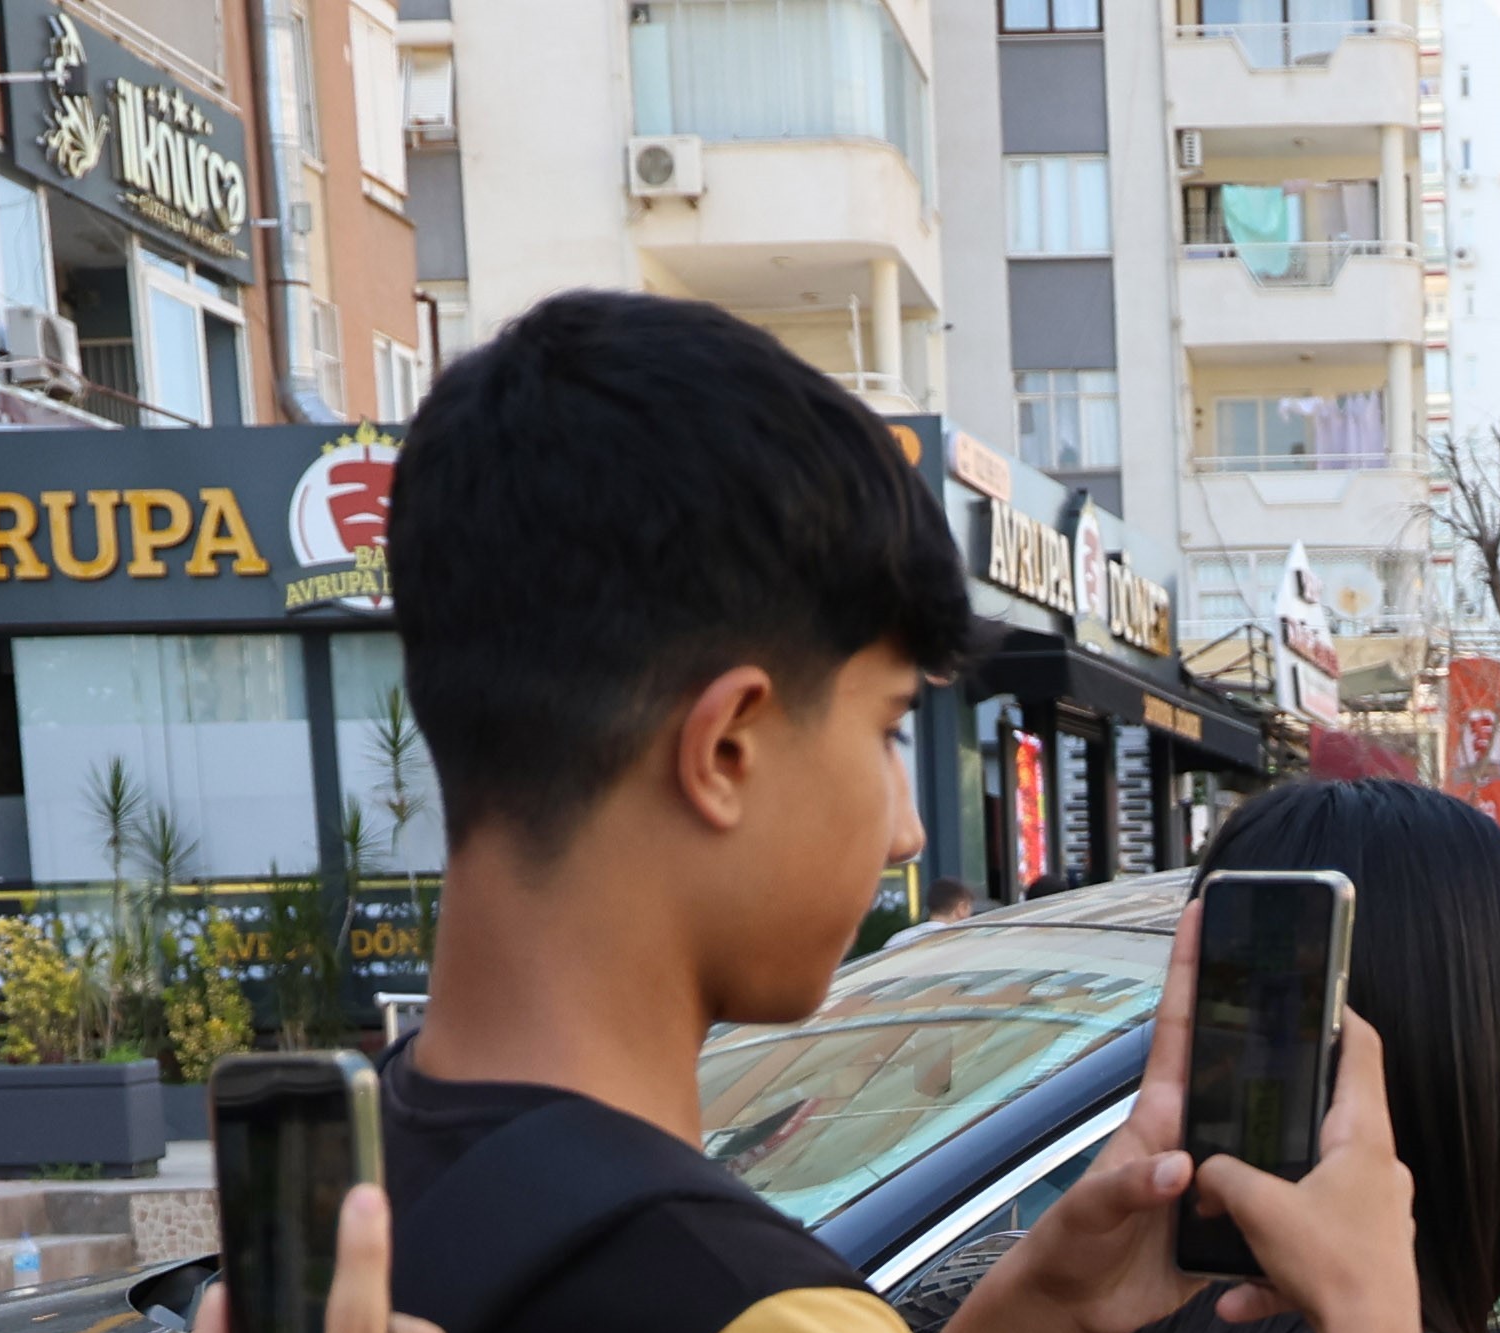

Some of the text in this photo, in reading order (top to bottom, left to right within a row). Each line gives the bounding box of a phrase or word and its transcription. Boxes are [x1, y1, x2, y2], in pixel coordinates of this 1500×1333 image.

[988, 497, 1075, 617] AVRUPA
[285, 570, 378, 609] AVRUPA
[349, 922, 423, 959] DÖN
